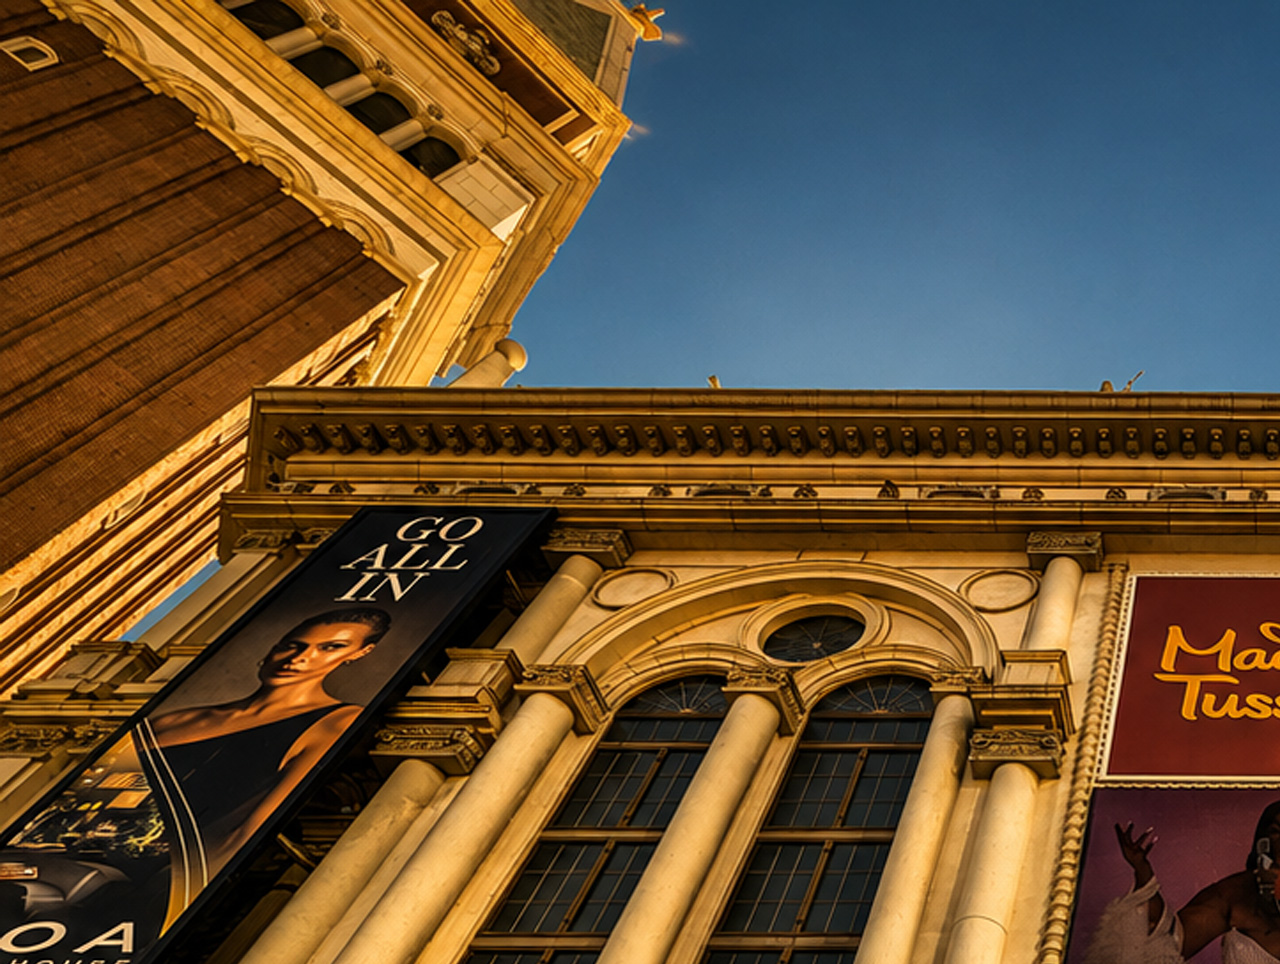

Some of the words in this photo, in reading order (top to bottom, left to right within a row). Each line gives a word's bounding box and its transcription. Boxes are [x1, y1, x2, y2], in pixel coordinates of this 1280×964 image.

[396, 516, 484, 542] GO
[339, 543, 468, 570] ALL
[334, 572, 430, 602] IN
